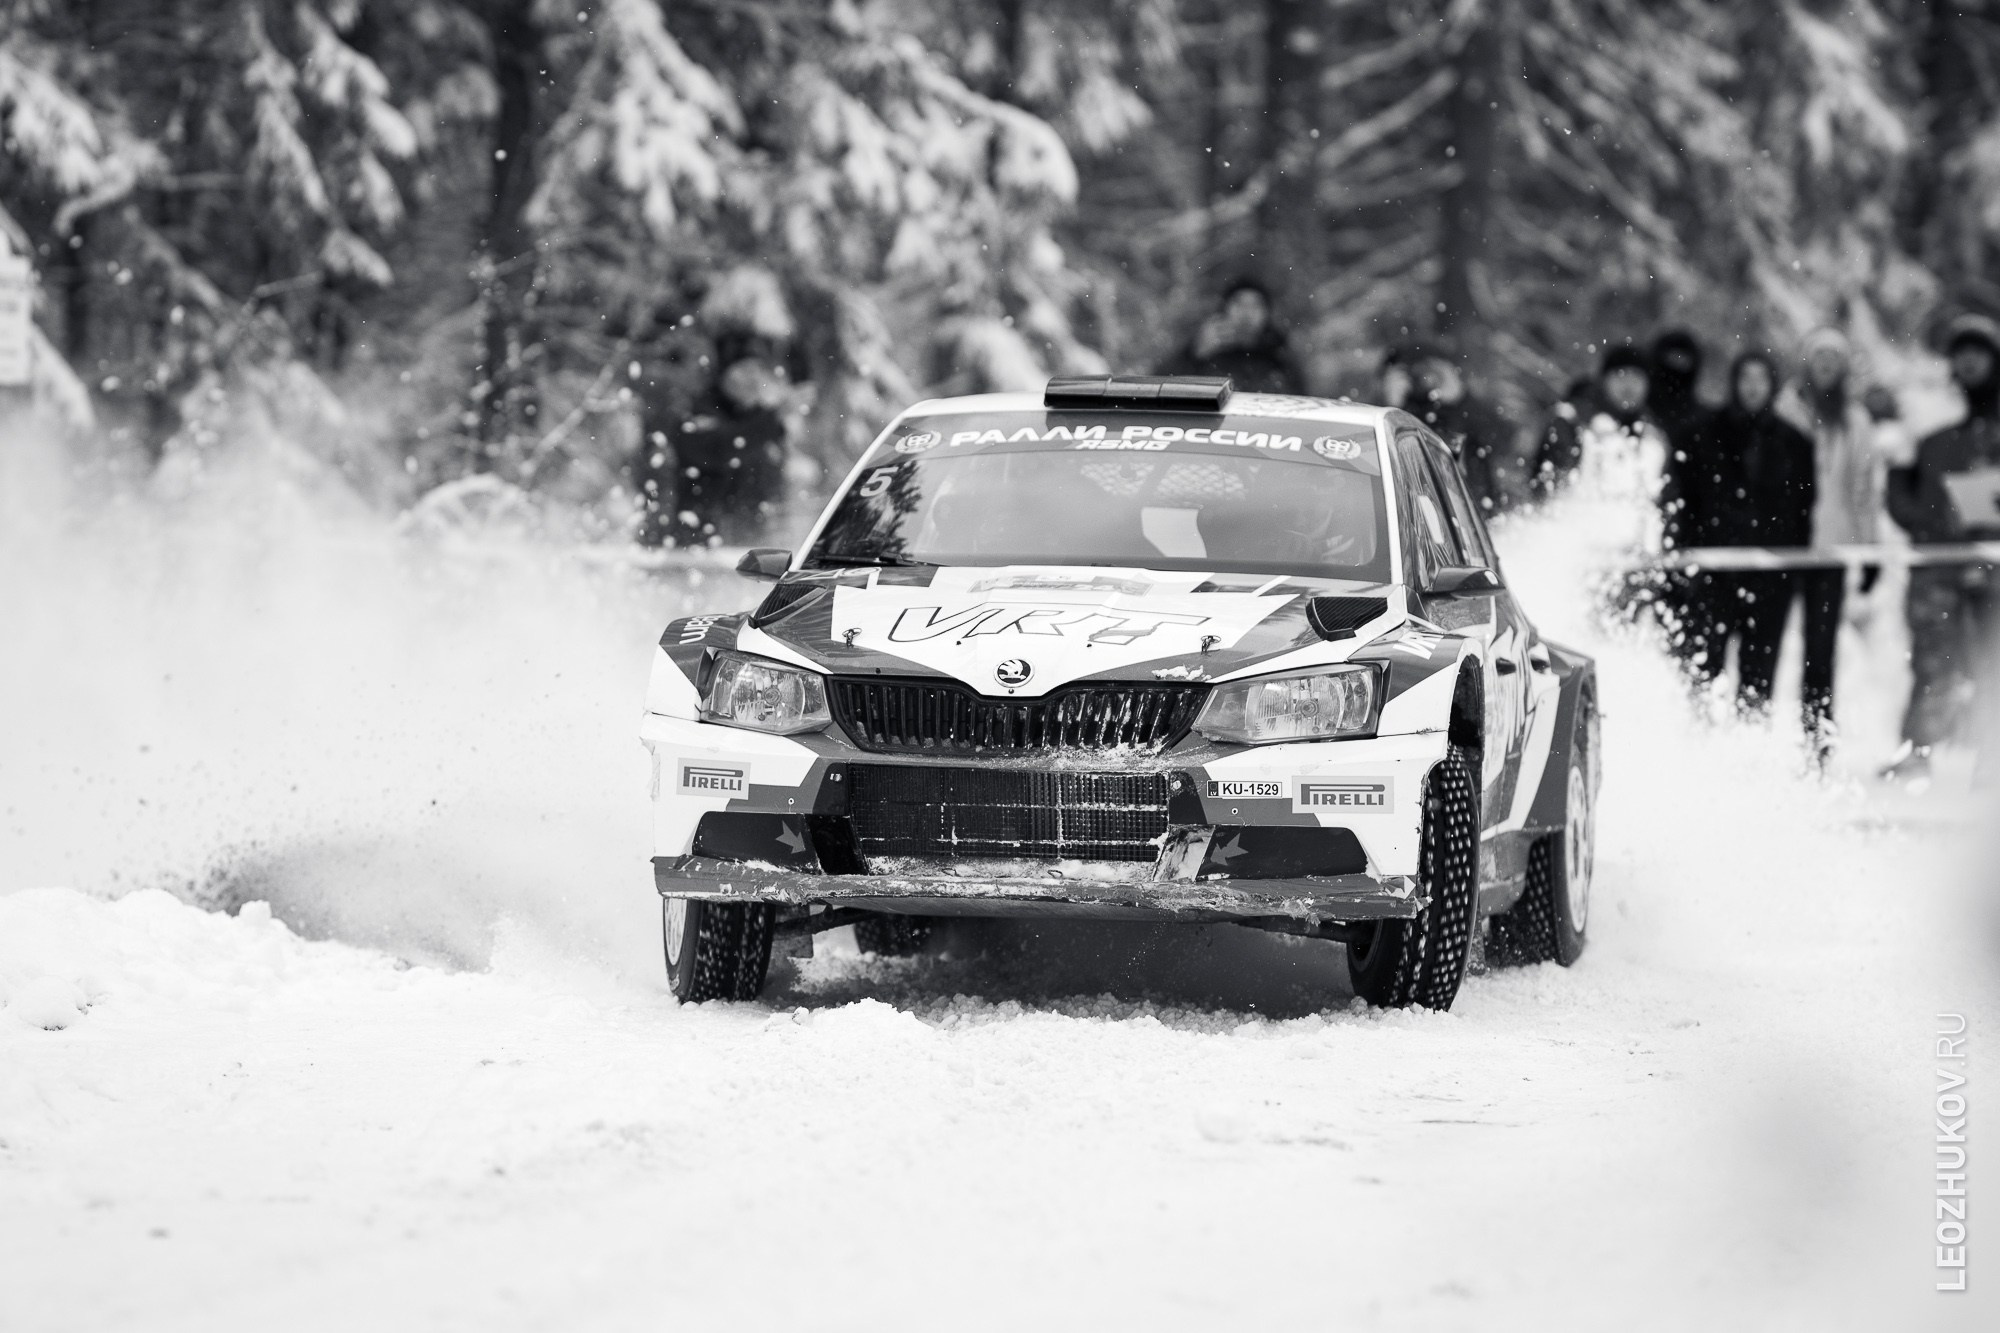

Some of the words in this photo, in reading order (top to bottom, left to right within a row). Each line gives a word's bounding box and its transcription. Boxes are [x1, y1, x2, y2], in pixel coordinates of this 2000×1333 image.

[950, 425, 1107, 447] РАЛЛИ
[1121, 425, 1302, 452] РОССИИ
[860, 466, 899, 497] 5
[887, 602, 1213, 646] VRT
[682, 766, 744, 792] PIRELLI
[1222, 783, 1279, 796] KU-1529
[1300, 783, 1386, 806] PIRELLI
